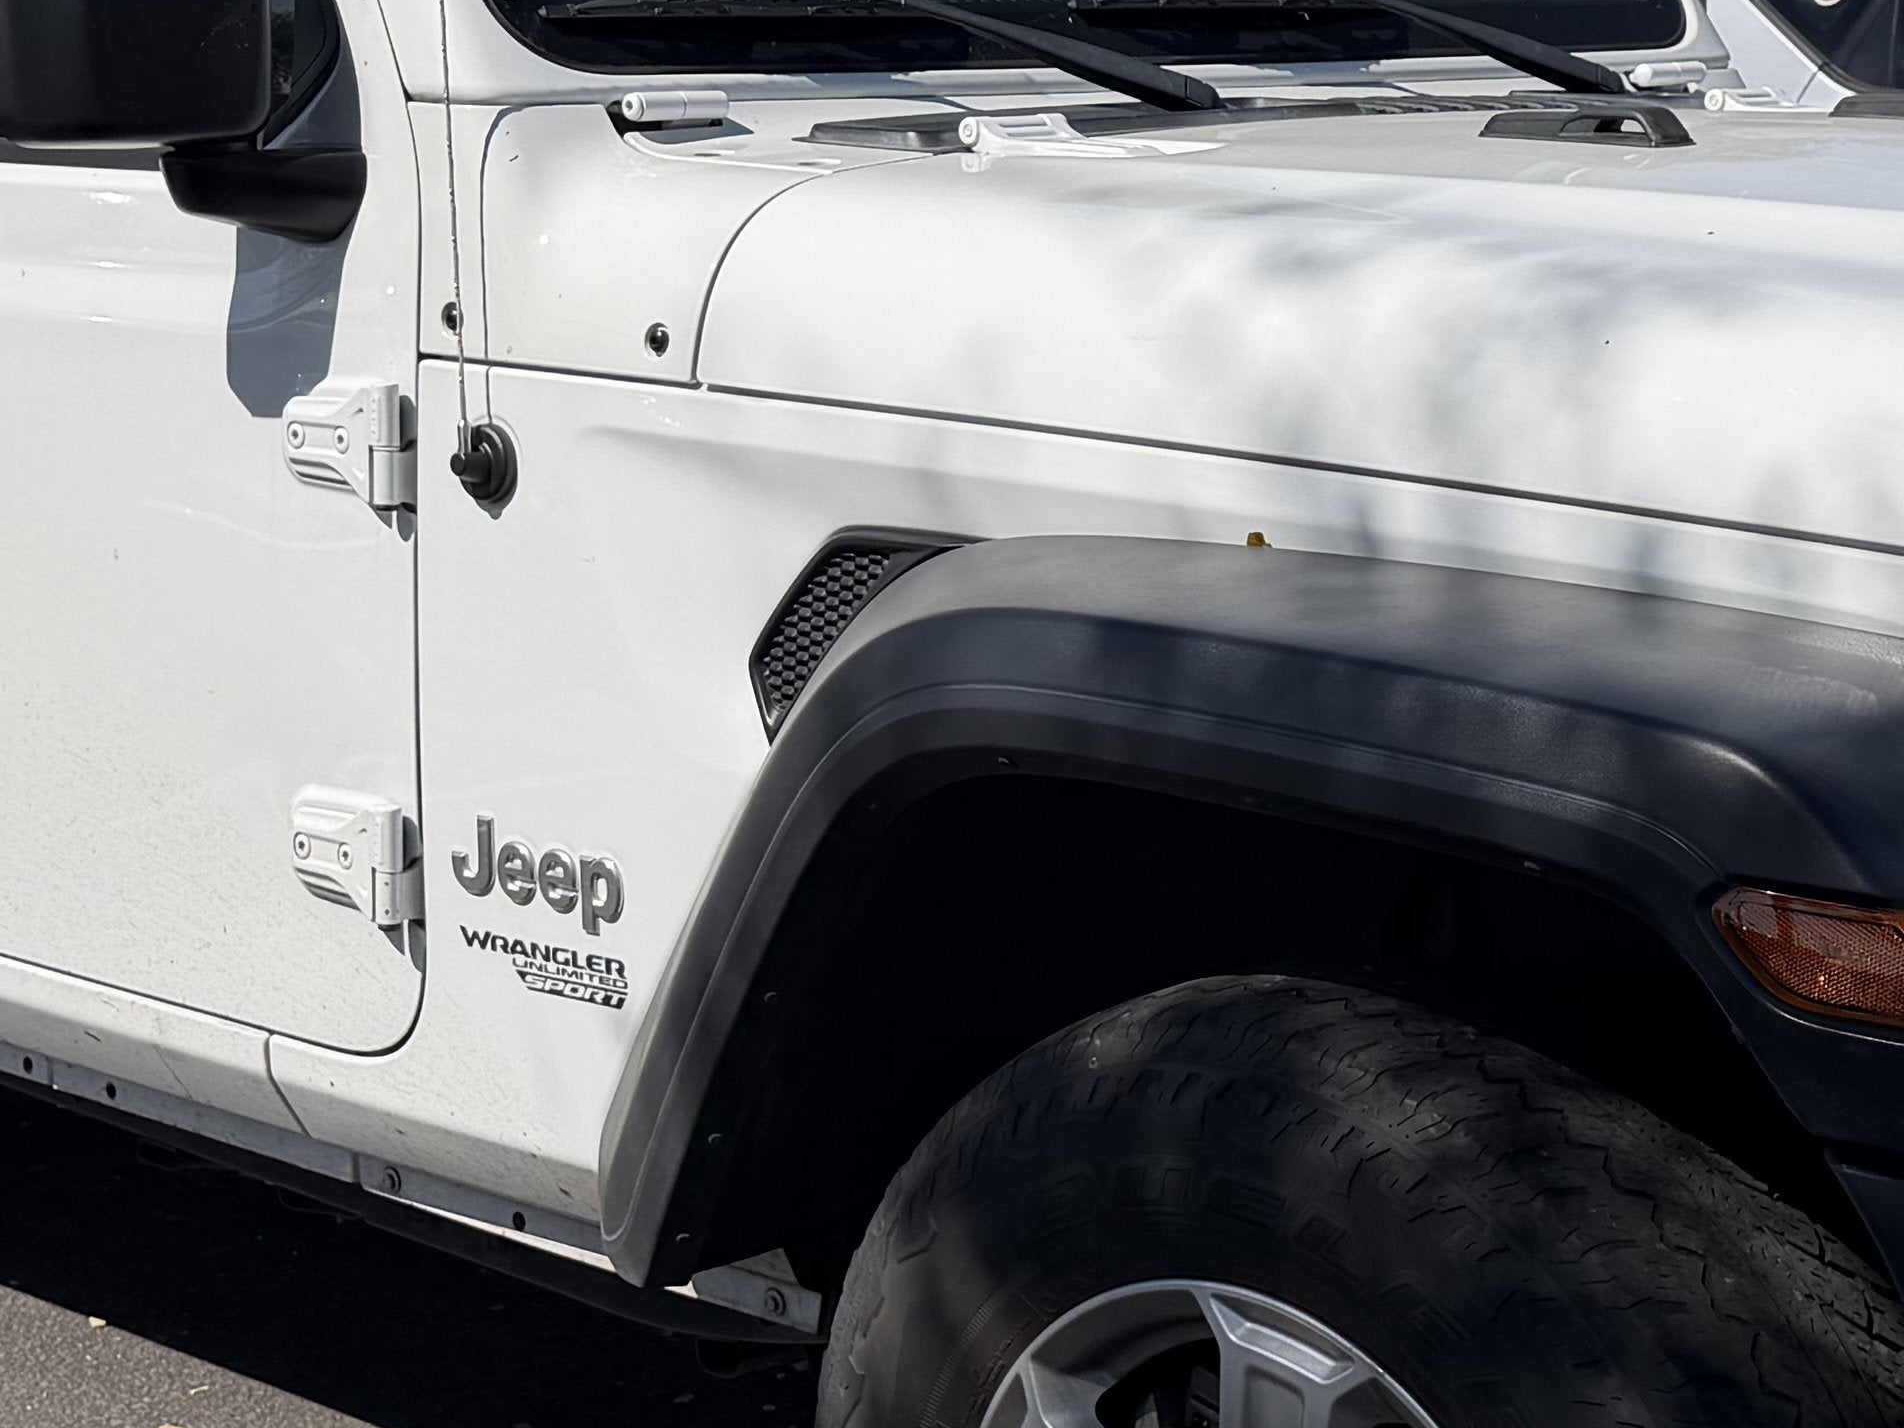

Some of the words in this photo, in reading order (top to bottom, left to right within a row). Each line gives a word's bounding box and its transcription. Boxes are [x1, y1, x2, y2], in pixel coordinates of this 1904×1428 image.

[451, 814, 625, 936] Jeep
[459, 924, 626, 979] WRANGLER
[512, 956, 629, 990] UNLIMITED
[523, 973, 628, 1009] SPORT
